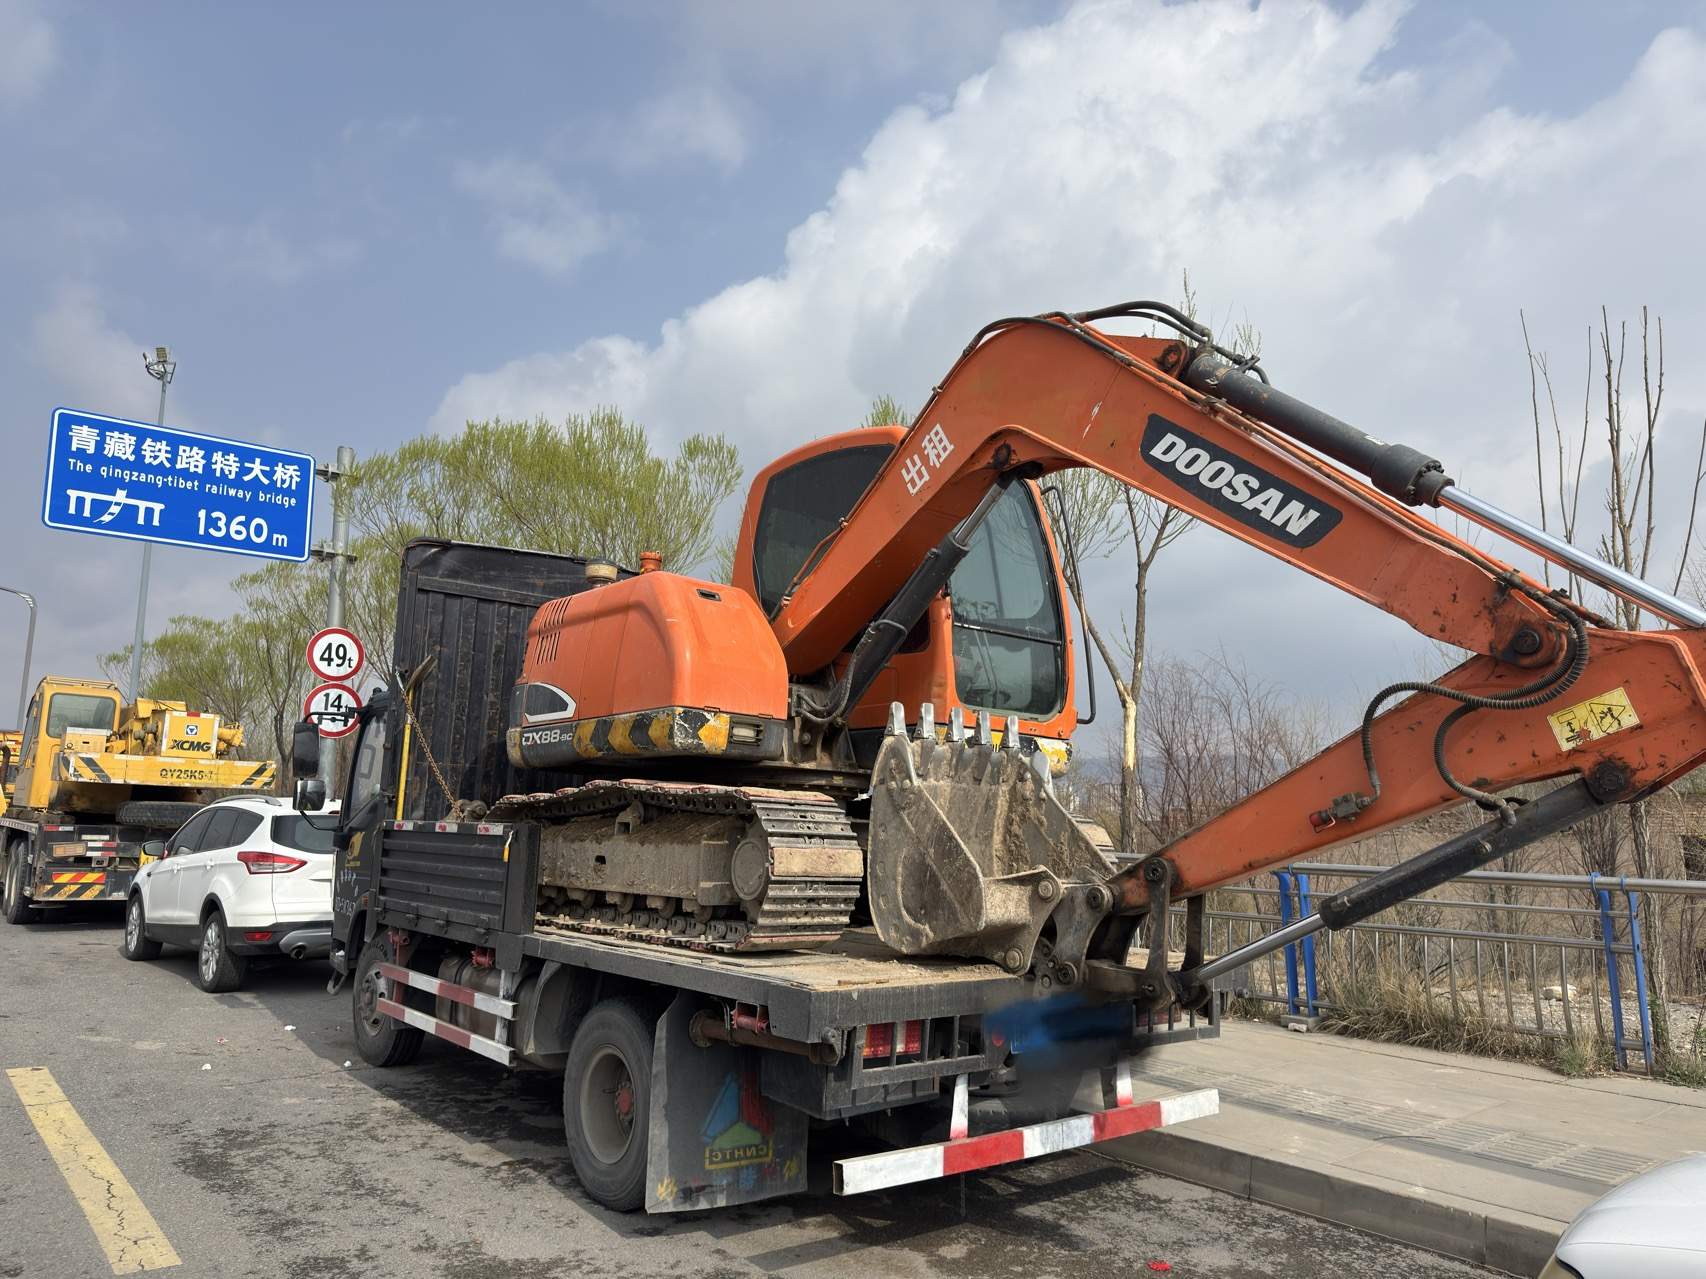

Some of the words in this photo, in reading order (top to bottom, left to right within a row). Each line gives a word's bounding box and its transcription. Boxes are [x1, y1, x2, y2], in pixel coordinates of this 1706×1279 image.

[68, 424, 301, 490] 青藏铁路特大桥
[68, 458, 93, 473] The
[100, 465, 199, 491] qingzang-tibet
[205, 483, 252, 503] railway
[259, 490, 297, 509] bridge
[901, 423, 955, 496] 出租
[1148, 432, 1321, 537] DOOSAN
[320, 642, 354, 668] 49t
[170, 739, 212, 752] XCMG
